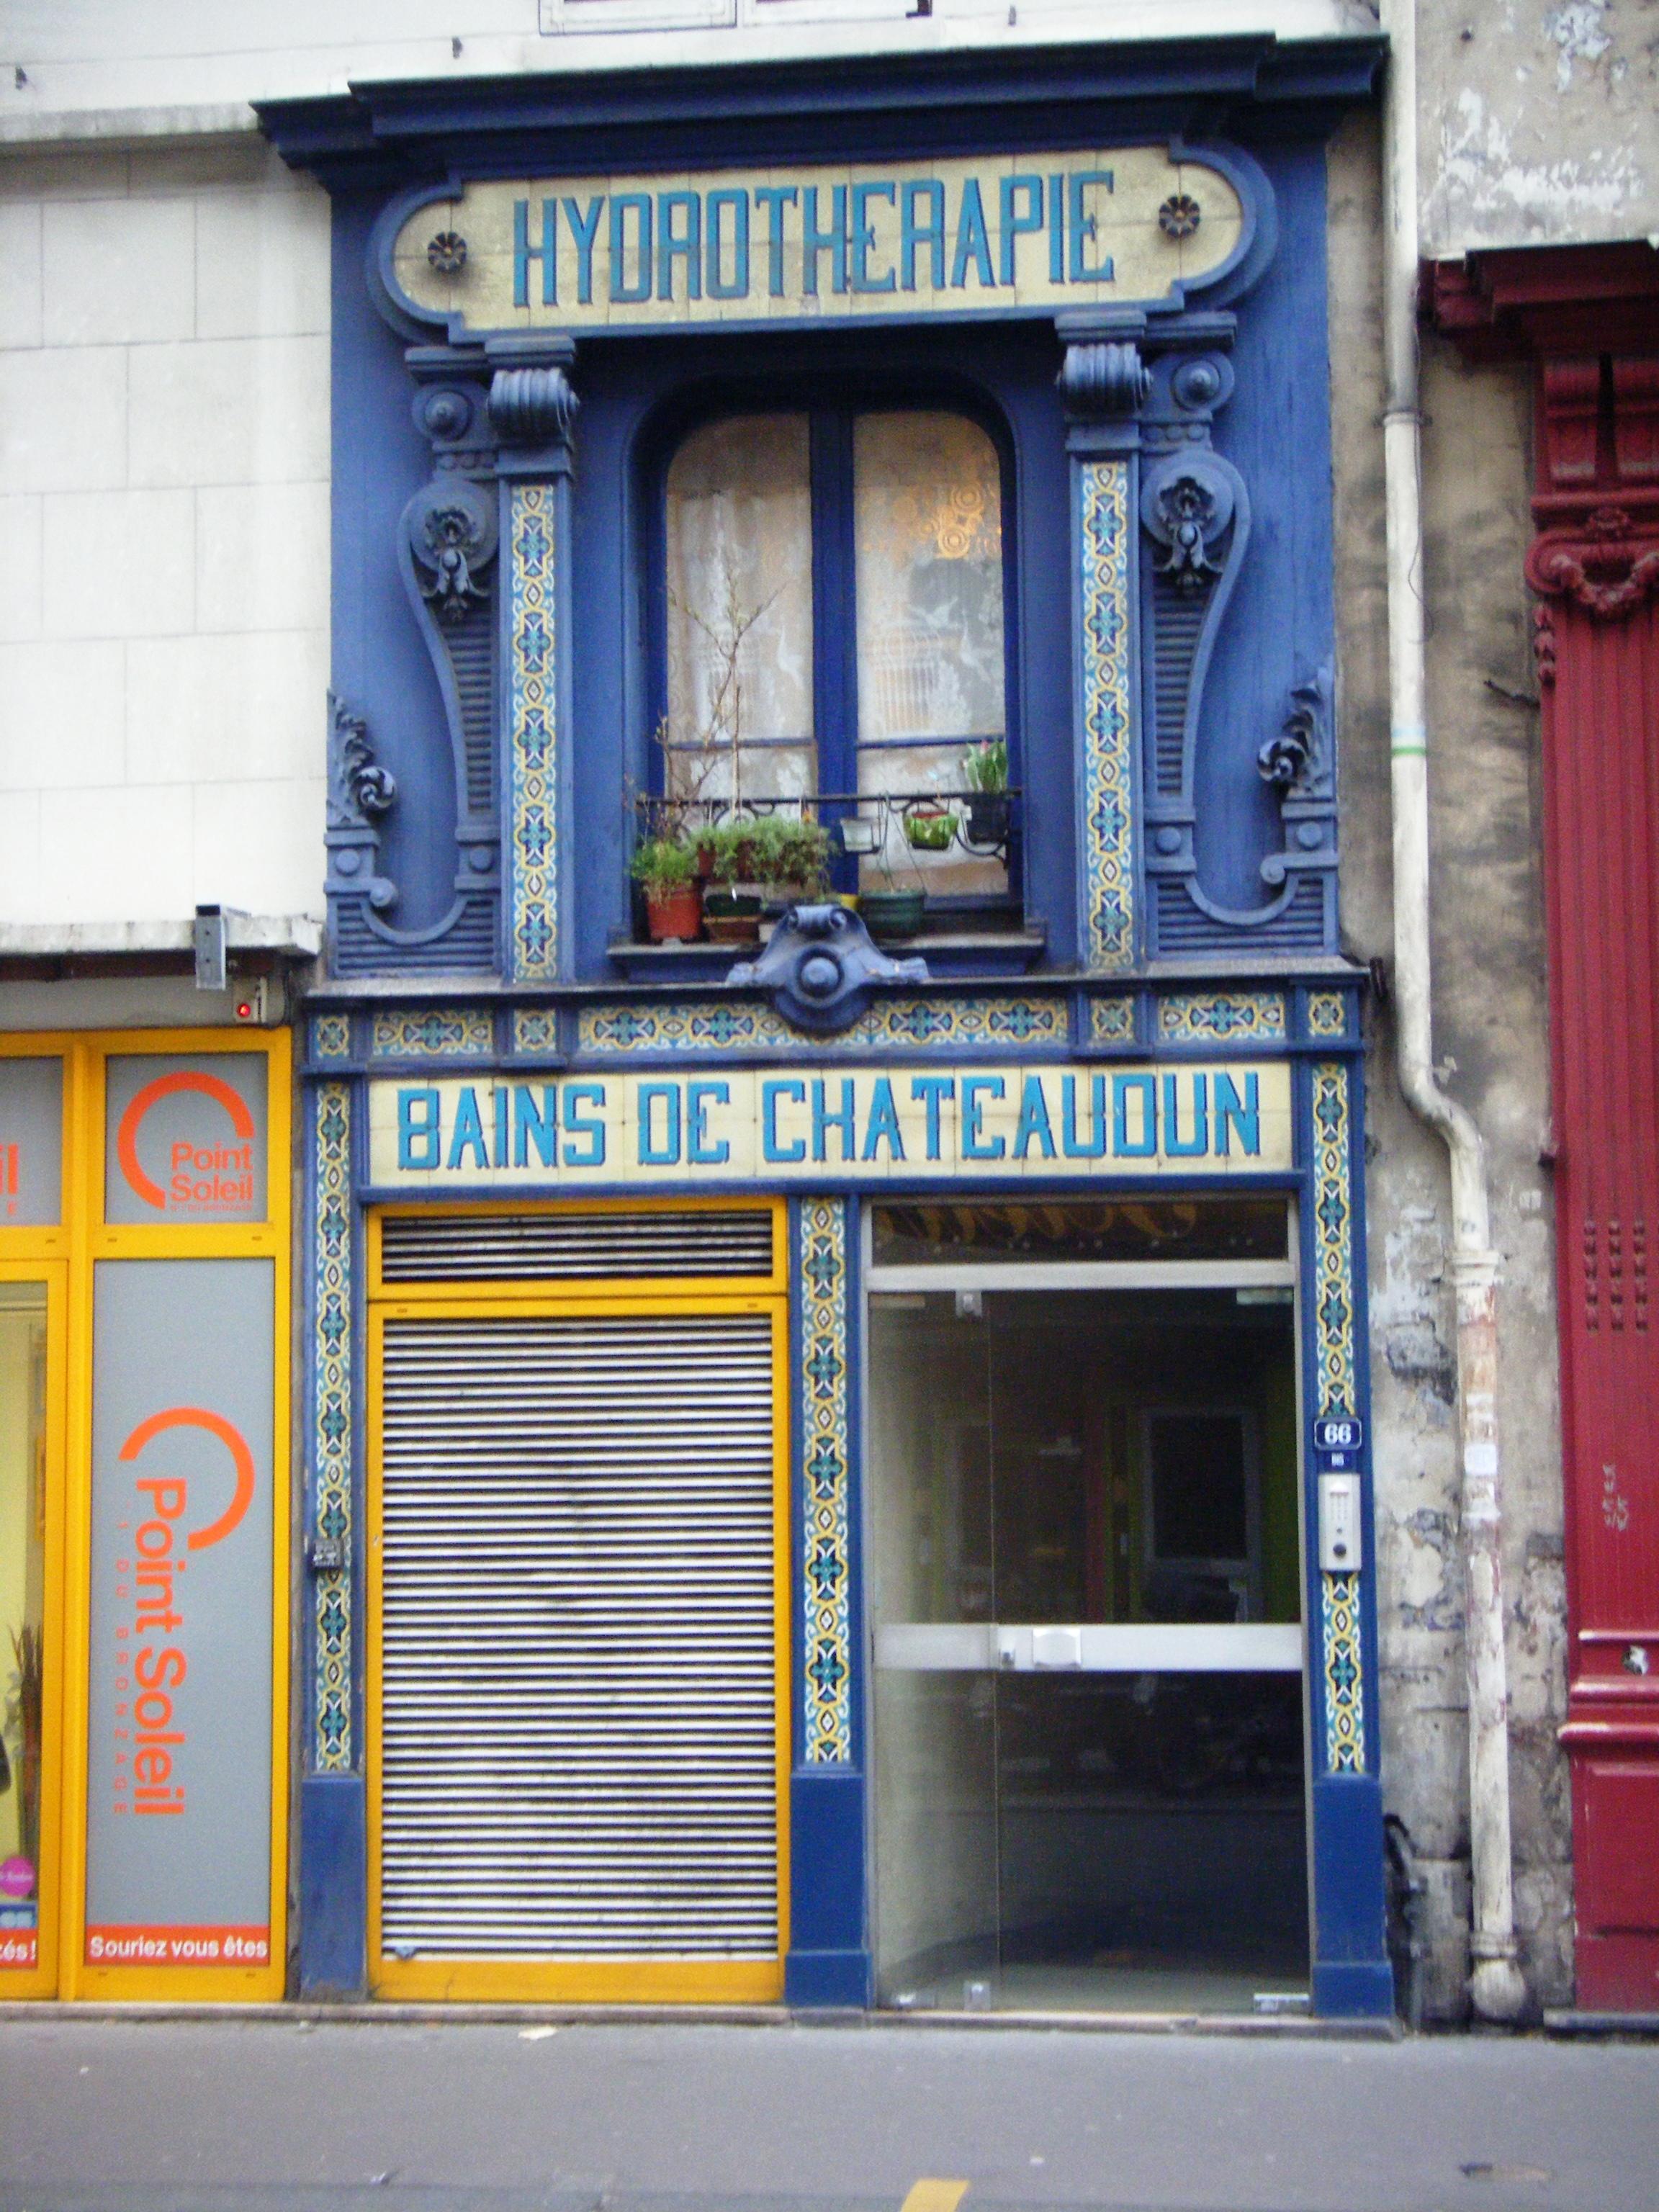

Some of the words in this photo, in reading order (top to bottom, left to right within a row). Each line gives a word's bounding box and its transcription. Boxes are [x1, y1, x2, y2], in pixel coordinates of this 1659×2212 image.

[512, 171, 1115, 307] HYDROTHERAPIE
[171, 1141, 253, 1172] Point
[397, 1084, 606, 1169] BAINS
[637, 1080, 730, 1165] DE
[762, 1072, 1259, 1160] CHATEAUDUN
[171, 1173, 253, 1201] Soleil
[1324, 1422, 1352, 1444] 66
[135, 1478, 186, 1633] Point
[115, 1627, 128, 1813] BRONZAGE
[134, 1647, 186, 1815] Soleil
[89, 1935, 167, 1959] Souriez
[171, 1938, 219, 1958] vous
[222, 1934, 268, 1958] êtes
